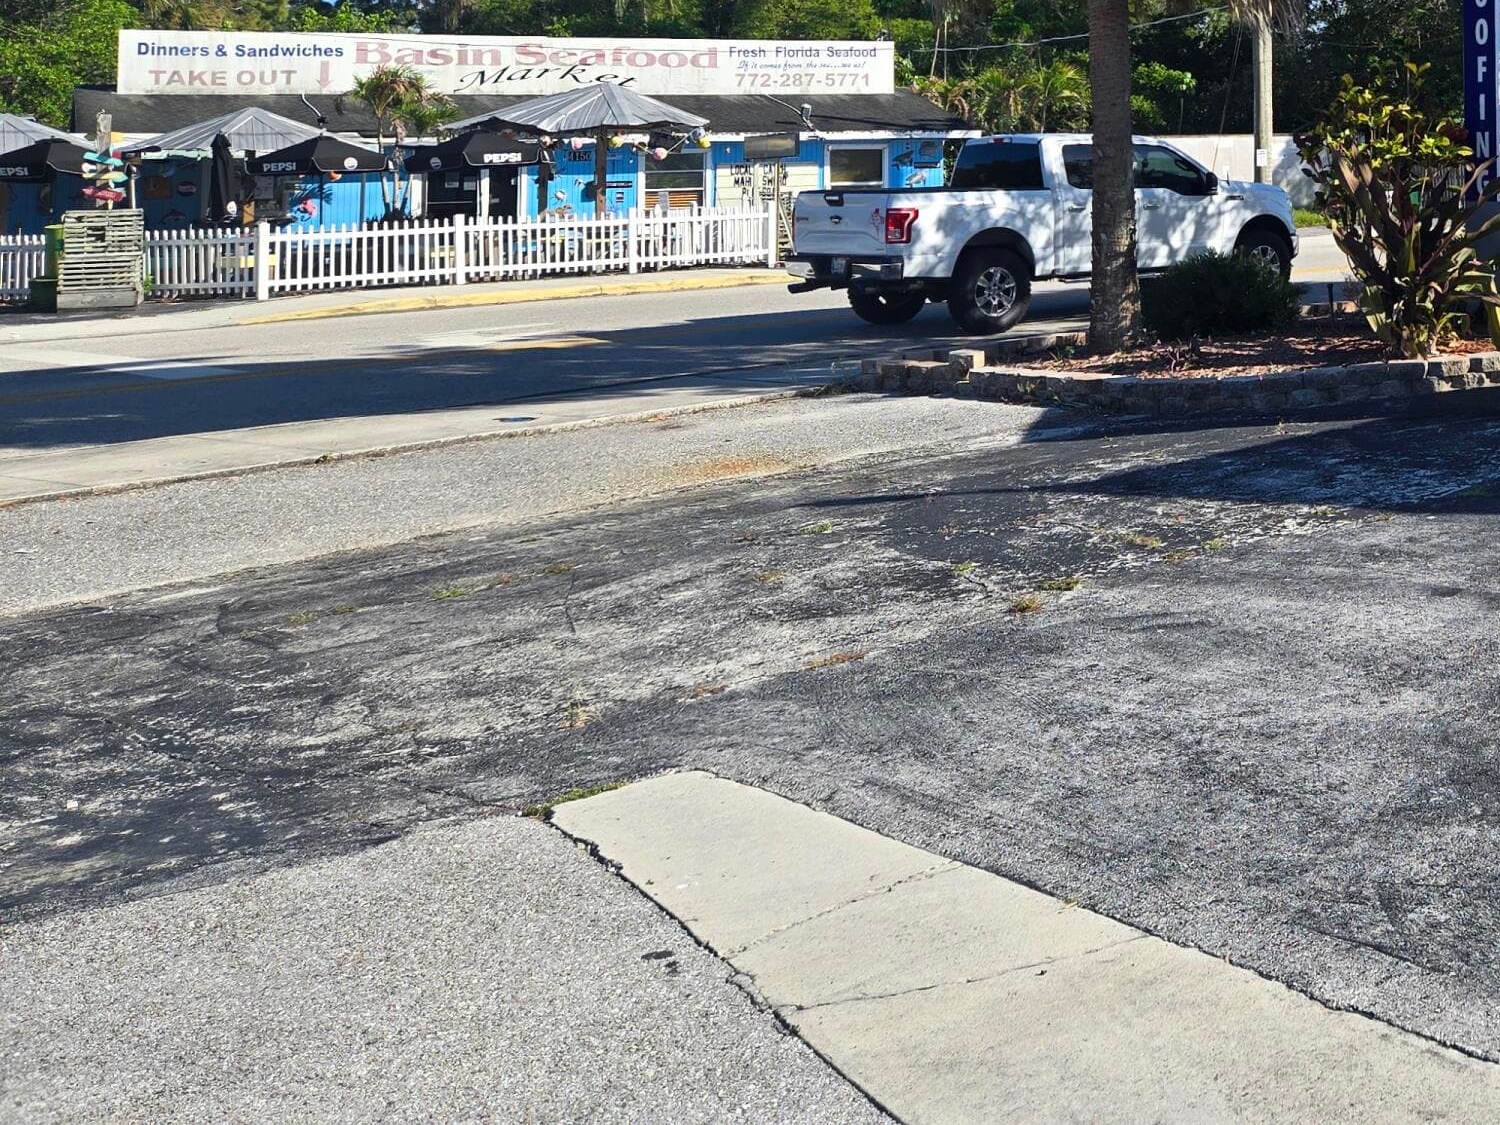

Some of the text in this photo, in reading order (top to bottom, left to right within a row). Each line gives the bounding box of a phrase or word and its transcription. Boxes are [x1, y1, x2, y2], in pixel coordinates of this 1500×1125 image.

[136, 41, 344, 58] Dinners & Sandwiches
[354, 41, 718, 69] Basin Seafood
[729, 46, 877, 58] Fresh Florida Seafood
[782, 61, 802, 71] from
[148, 69, 298, 86] TAKE OUT
[454, 64, 637, 93] Market
[735, 73, 869, 87] 772-287-5771
[484, 153, 522, 163] PEPSI
[263, 162, 297, 172] PEPSI
[730, 164, 753, 175] LOCAL
